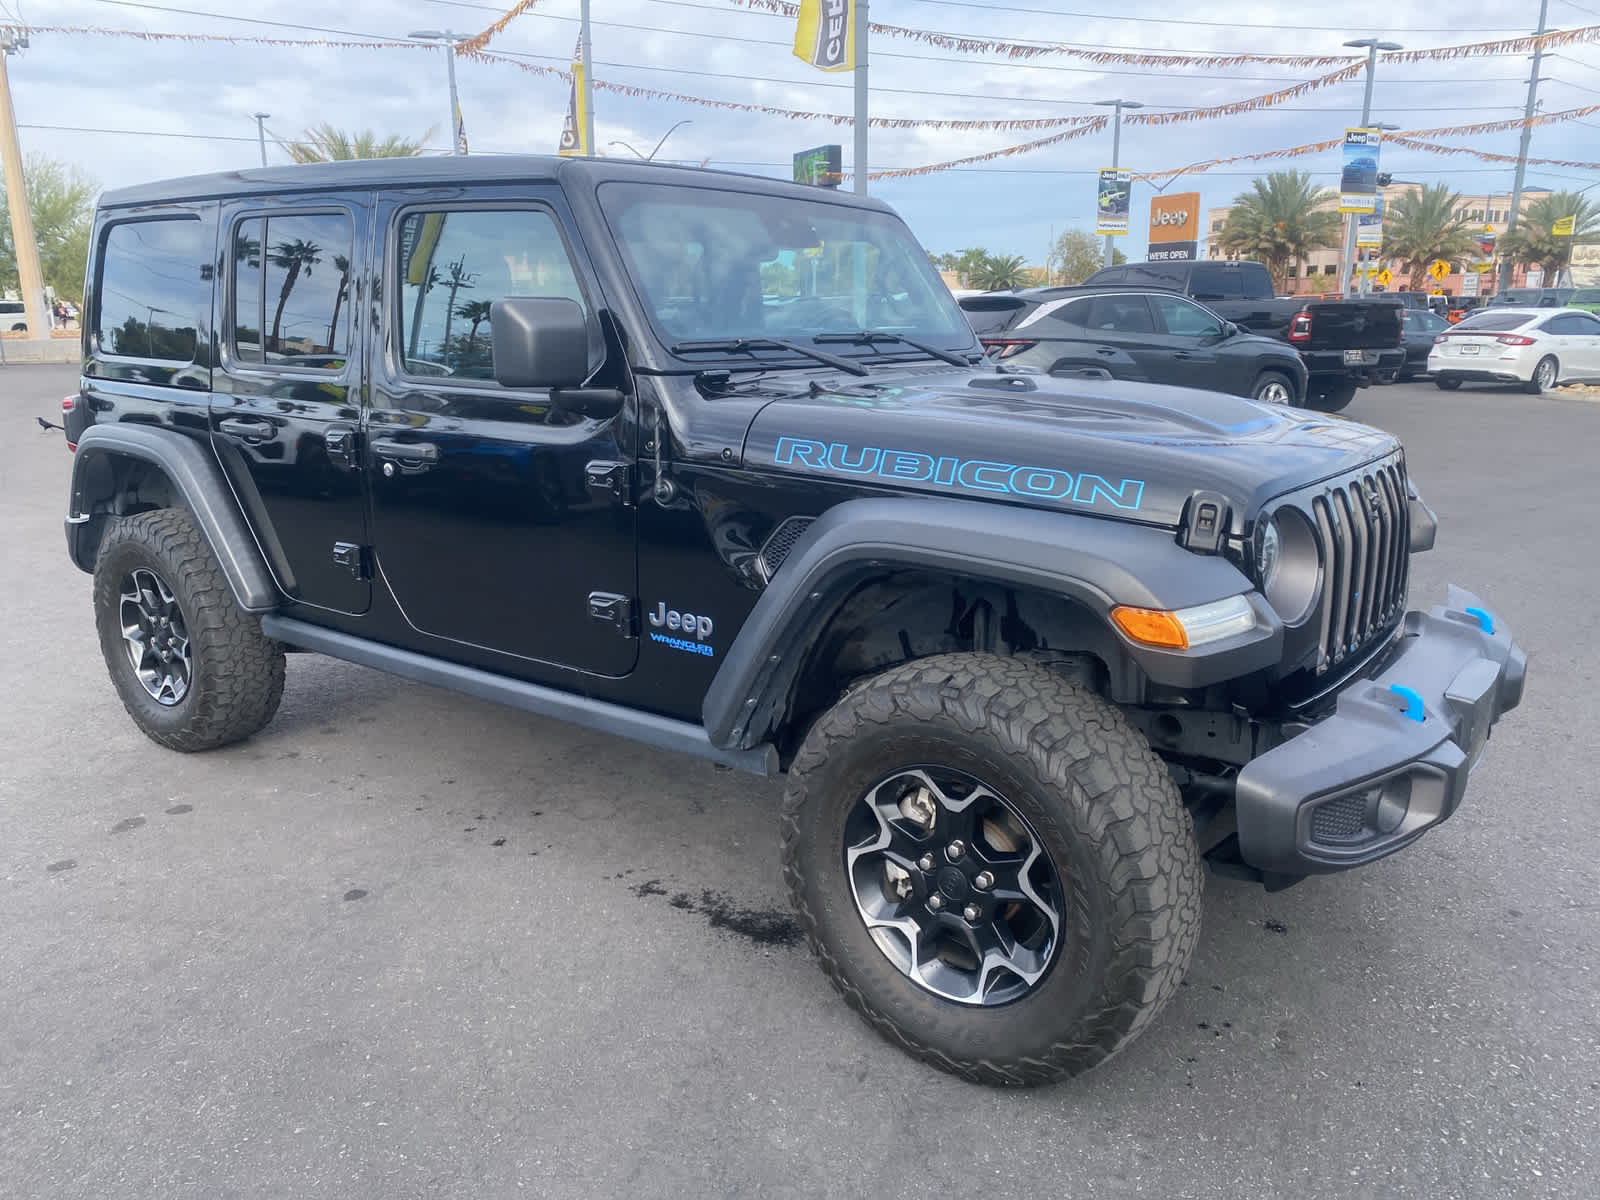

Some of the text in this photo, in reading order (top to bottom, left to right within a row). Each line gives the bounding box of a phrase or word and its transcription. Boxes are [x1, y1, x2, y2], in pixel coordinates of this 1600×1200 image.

[1152, 208, 1188, 228] Jeep
[1169, 250, 1189, 260] OPEN
[774, 436, 1145, 510] RUBICON
[649, 601, 713, 641] Jeep
[649, 631, 713, 654] WRANGLER
